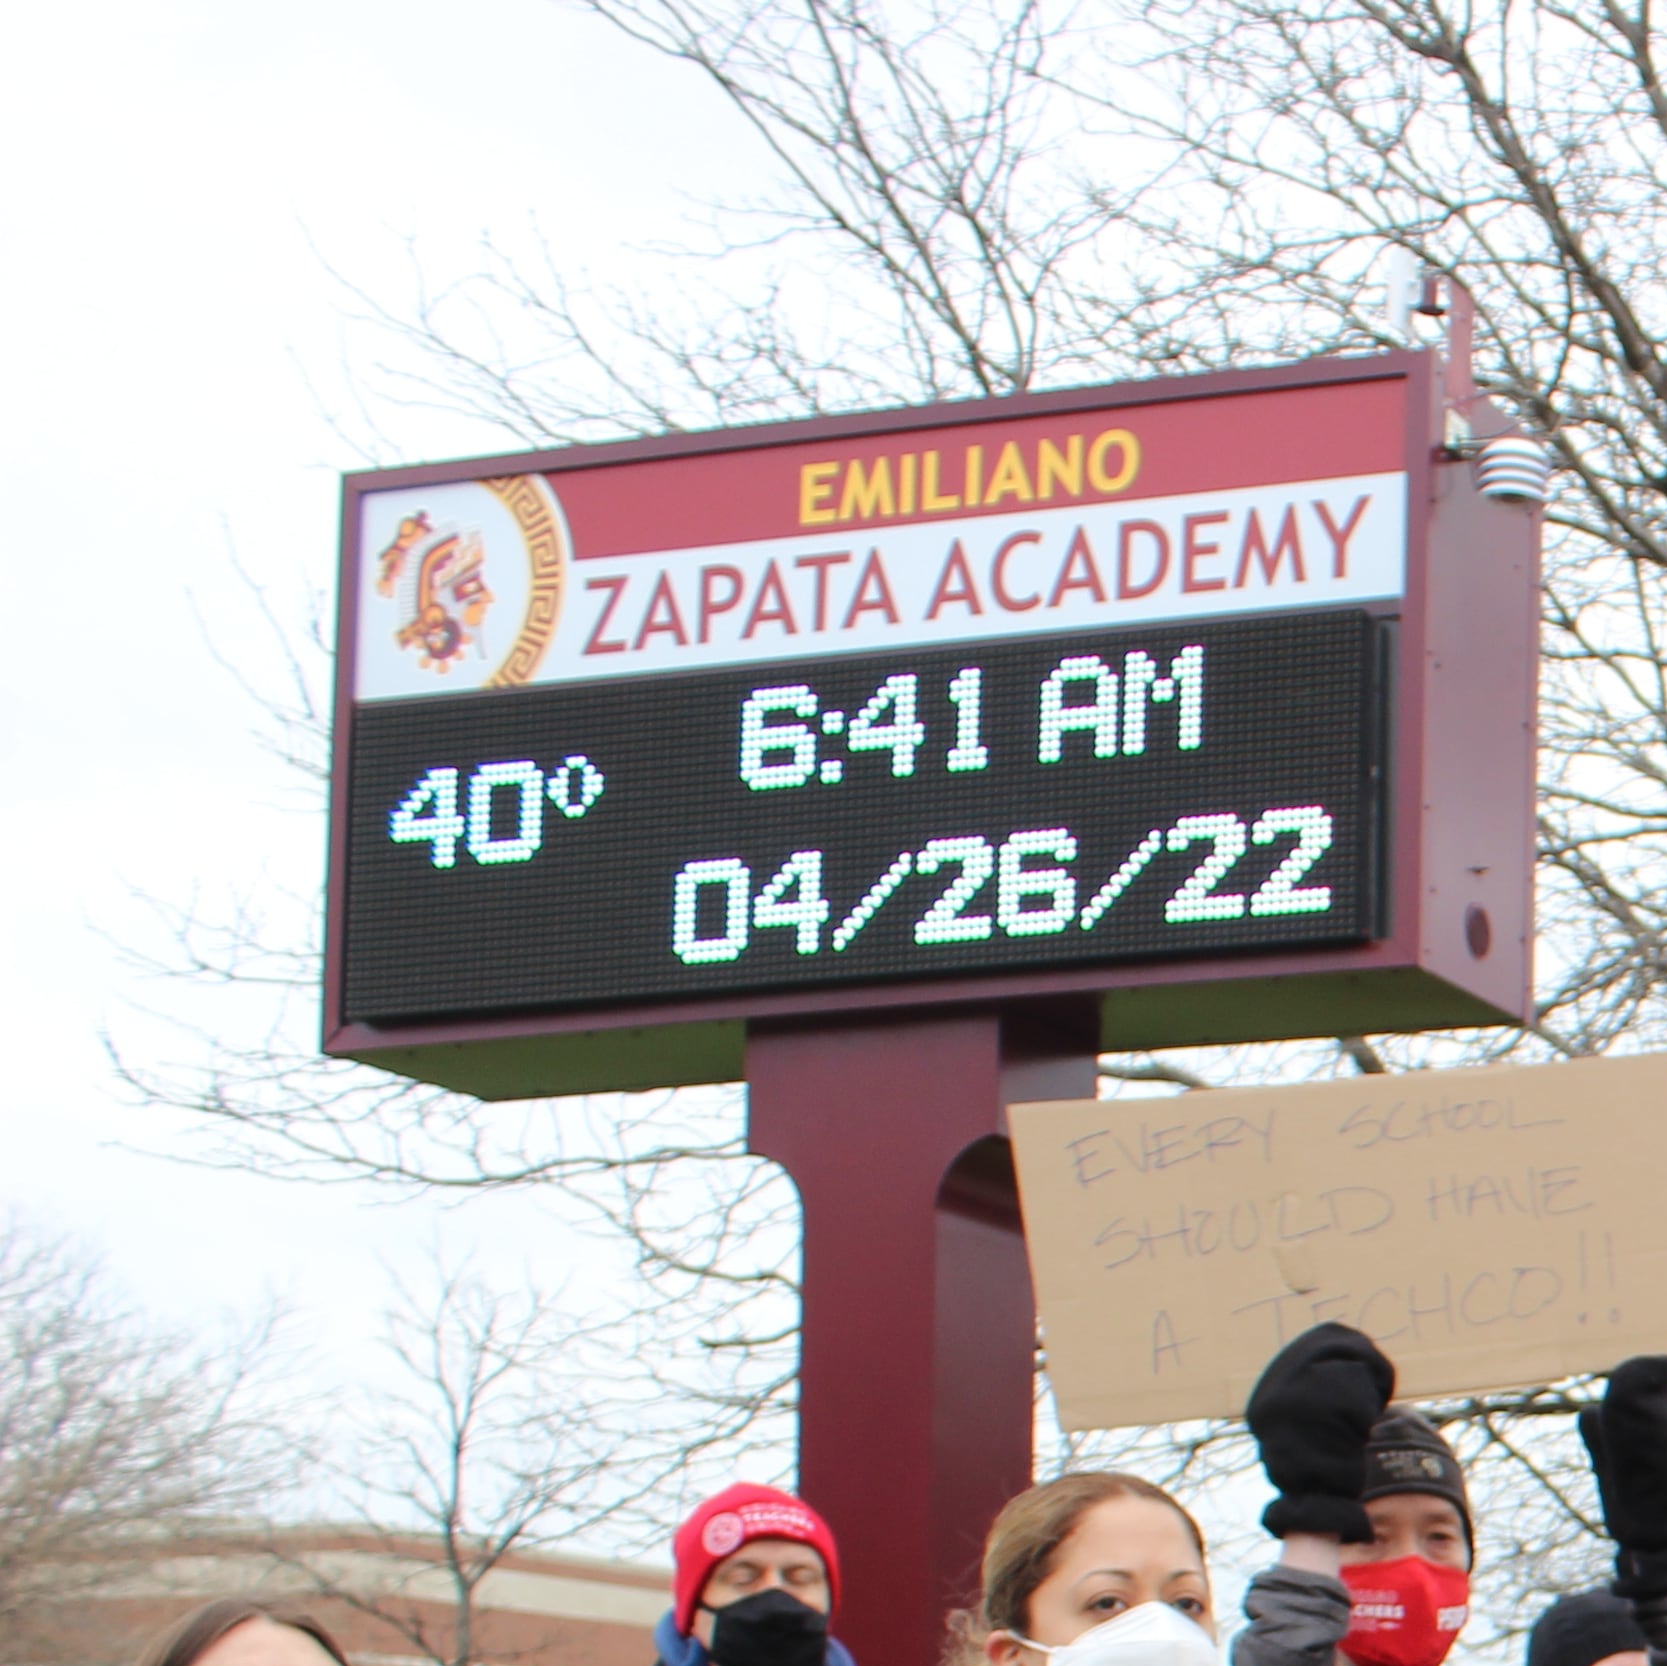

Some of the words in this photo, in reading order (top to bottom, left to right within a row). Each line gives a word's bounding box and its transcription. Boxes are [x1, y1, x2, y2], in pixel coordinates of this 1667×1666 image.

[798, 428, 1141, 526] EMILIANO
[583, 548, 899, 658] ZAPATA
[925, 495, 1374, 621] ACADEMY
[739, 666, 989, 791] 6:41
[1039, 645, 1204, 762] AM
[673, 806, 1333, 965] 04/26/22
[1064, 1109, 1277, 1188] EVERY
[1337, 1093, 1566, 1150] SCHOOL
[1093, 1187, 1396, 1269] SHOULD
[1427, 1165, 1595, 1223] HAVE
[1150, 1308, 1200, 1375] A
